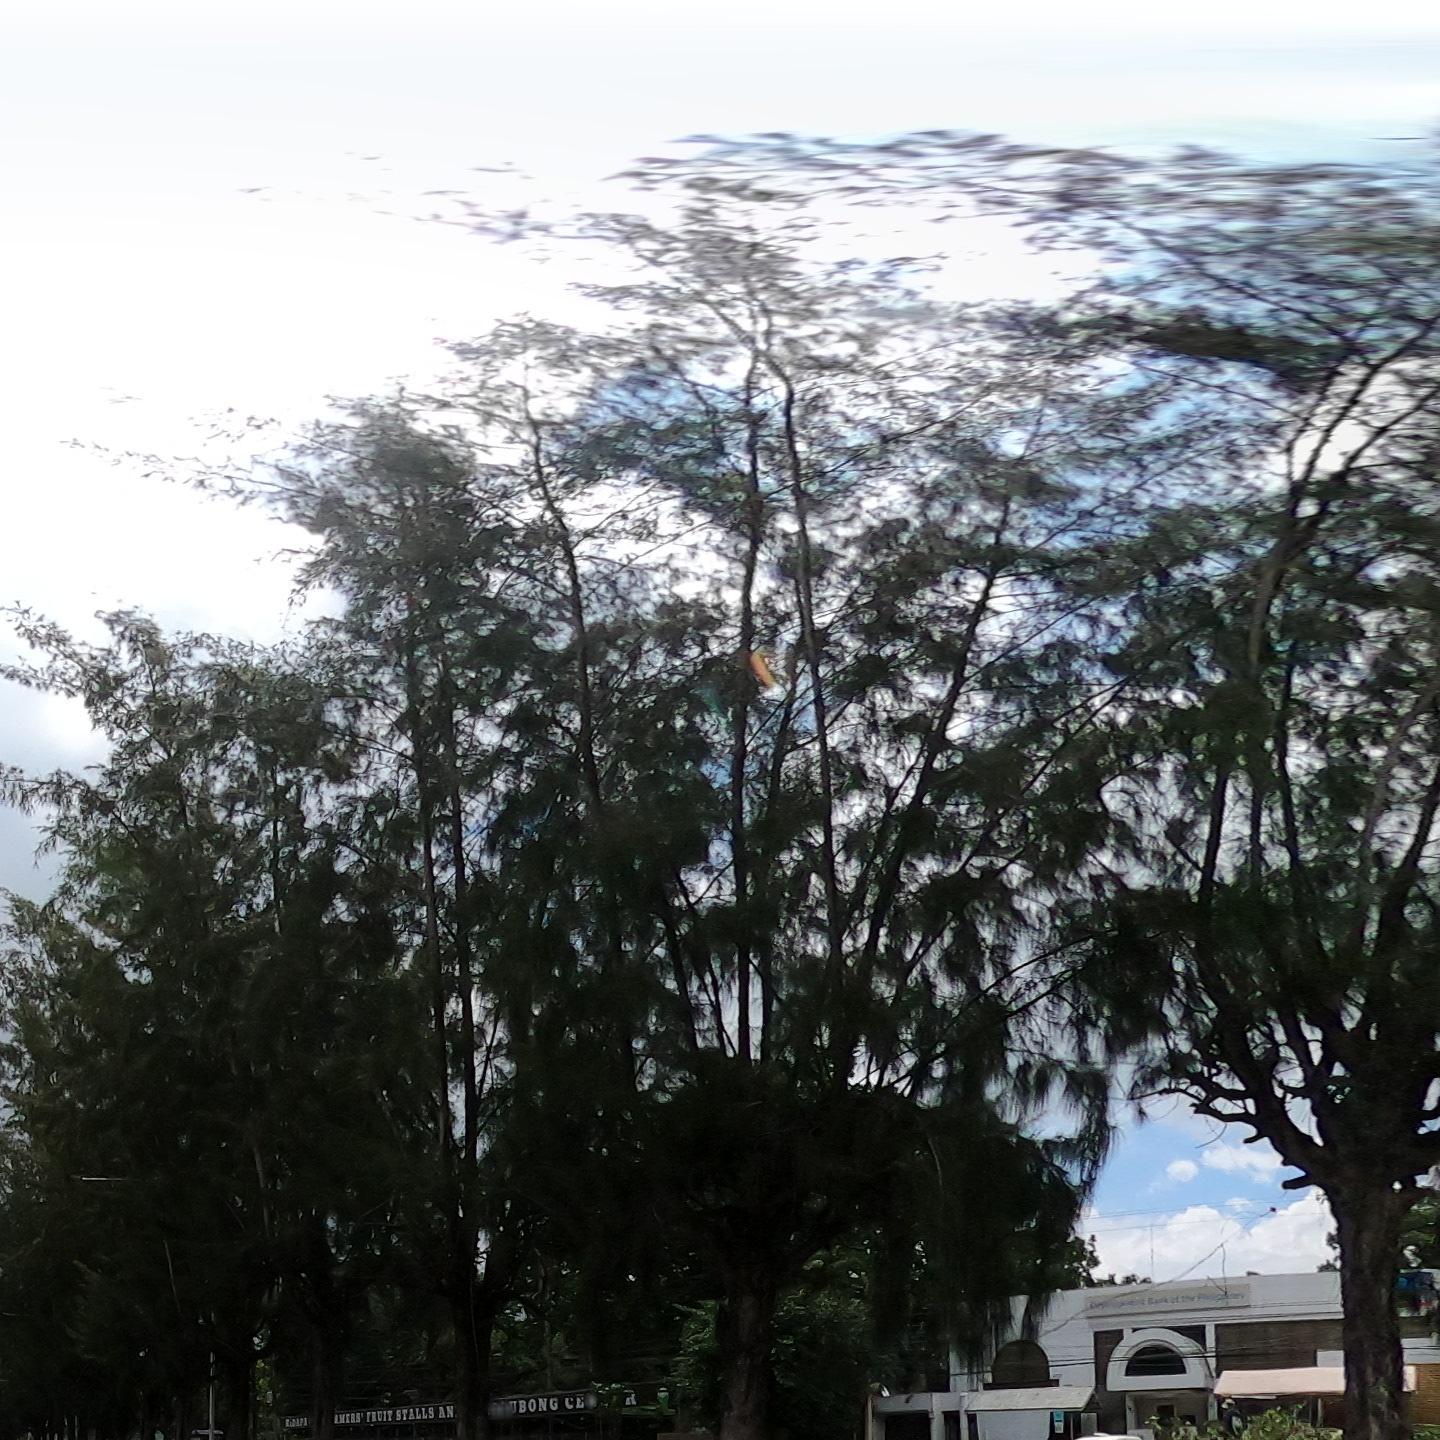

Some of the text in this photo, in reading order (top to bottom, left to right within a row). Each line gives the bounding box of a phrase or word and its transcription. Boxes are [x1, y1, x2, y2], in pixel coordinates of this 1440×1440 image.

[366, 1409, 393, 1422] FRUIT
[396, 1406, 435, 1421] STALLS
[438, 1404, 456, 1419] AN
